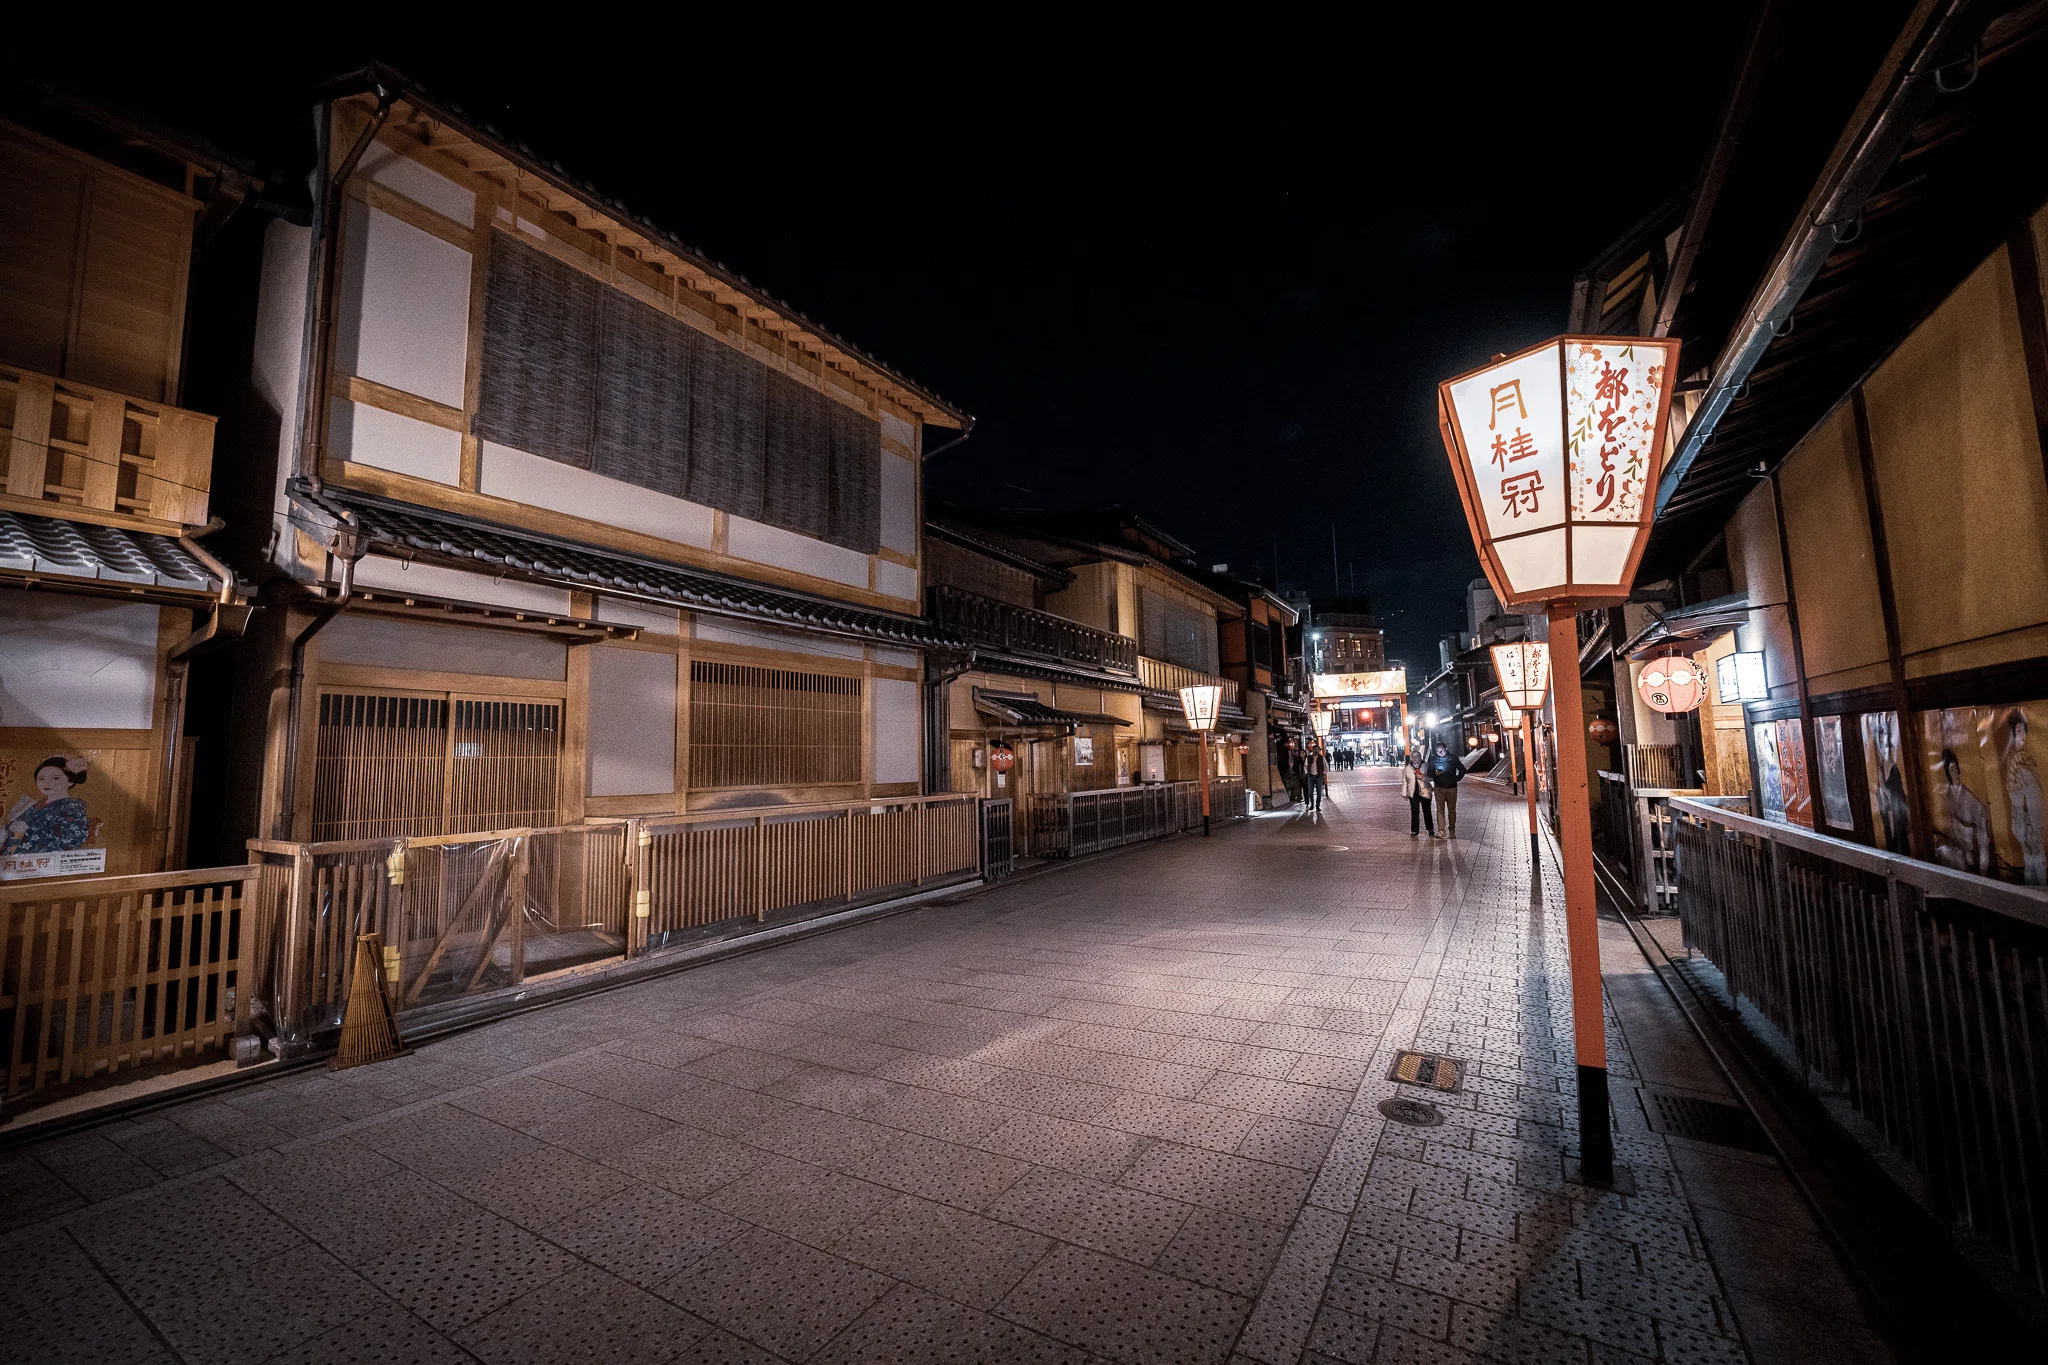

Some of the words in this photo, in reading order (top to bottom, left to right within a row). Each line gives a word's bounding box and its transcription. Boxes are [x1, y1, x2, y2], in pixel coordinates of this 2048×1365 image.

[1489, 378, 1545, 519] 月桂冠
[1590, 360, 1629, 514] 都をどり
[1337, 675, 1383, 694] 都をどり
[2, 857, 51, 872] 月桂冠
